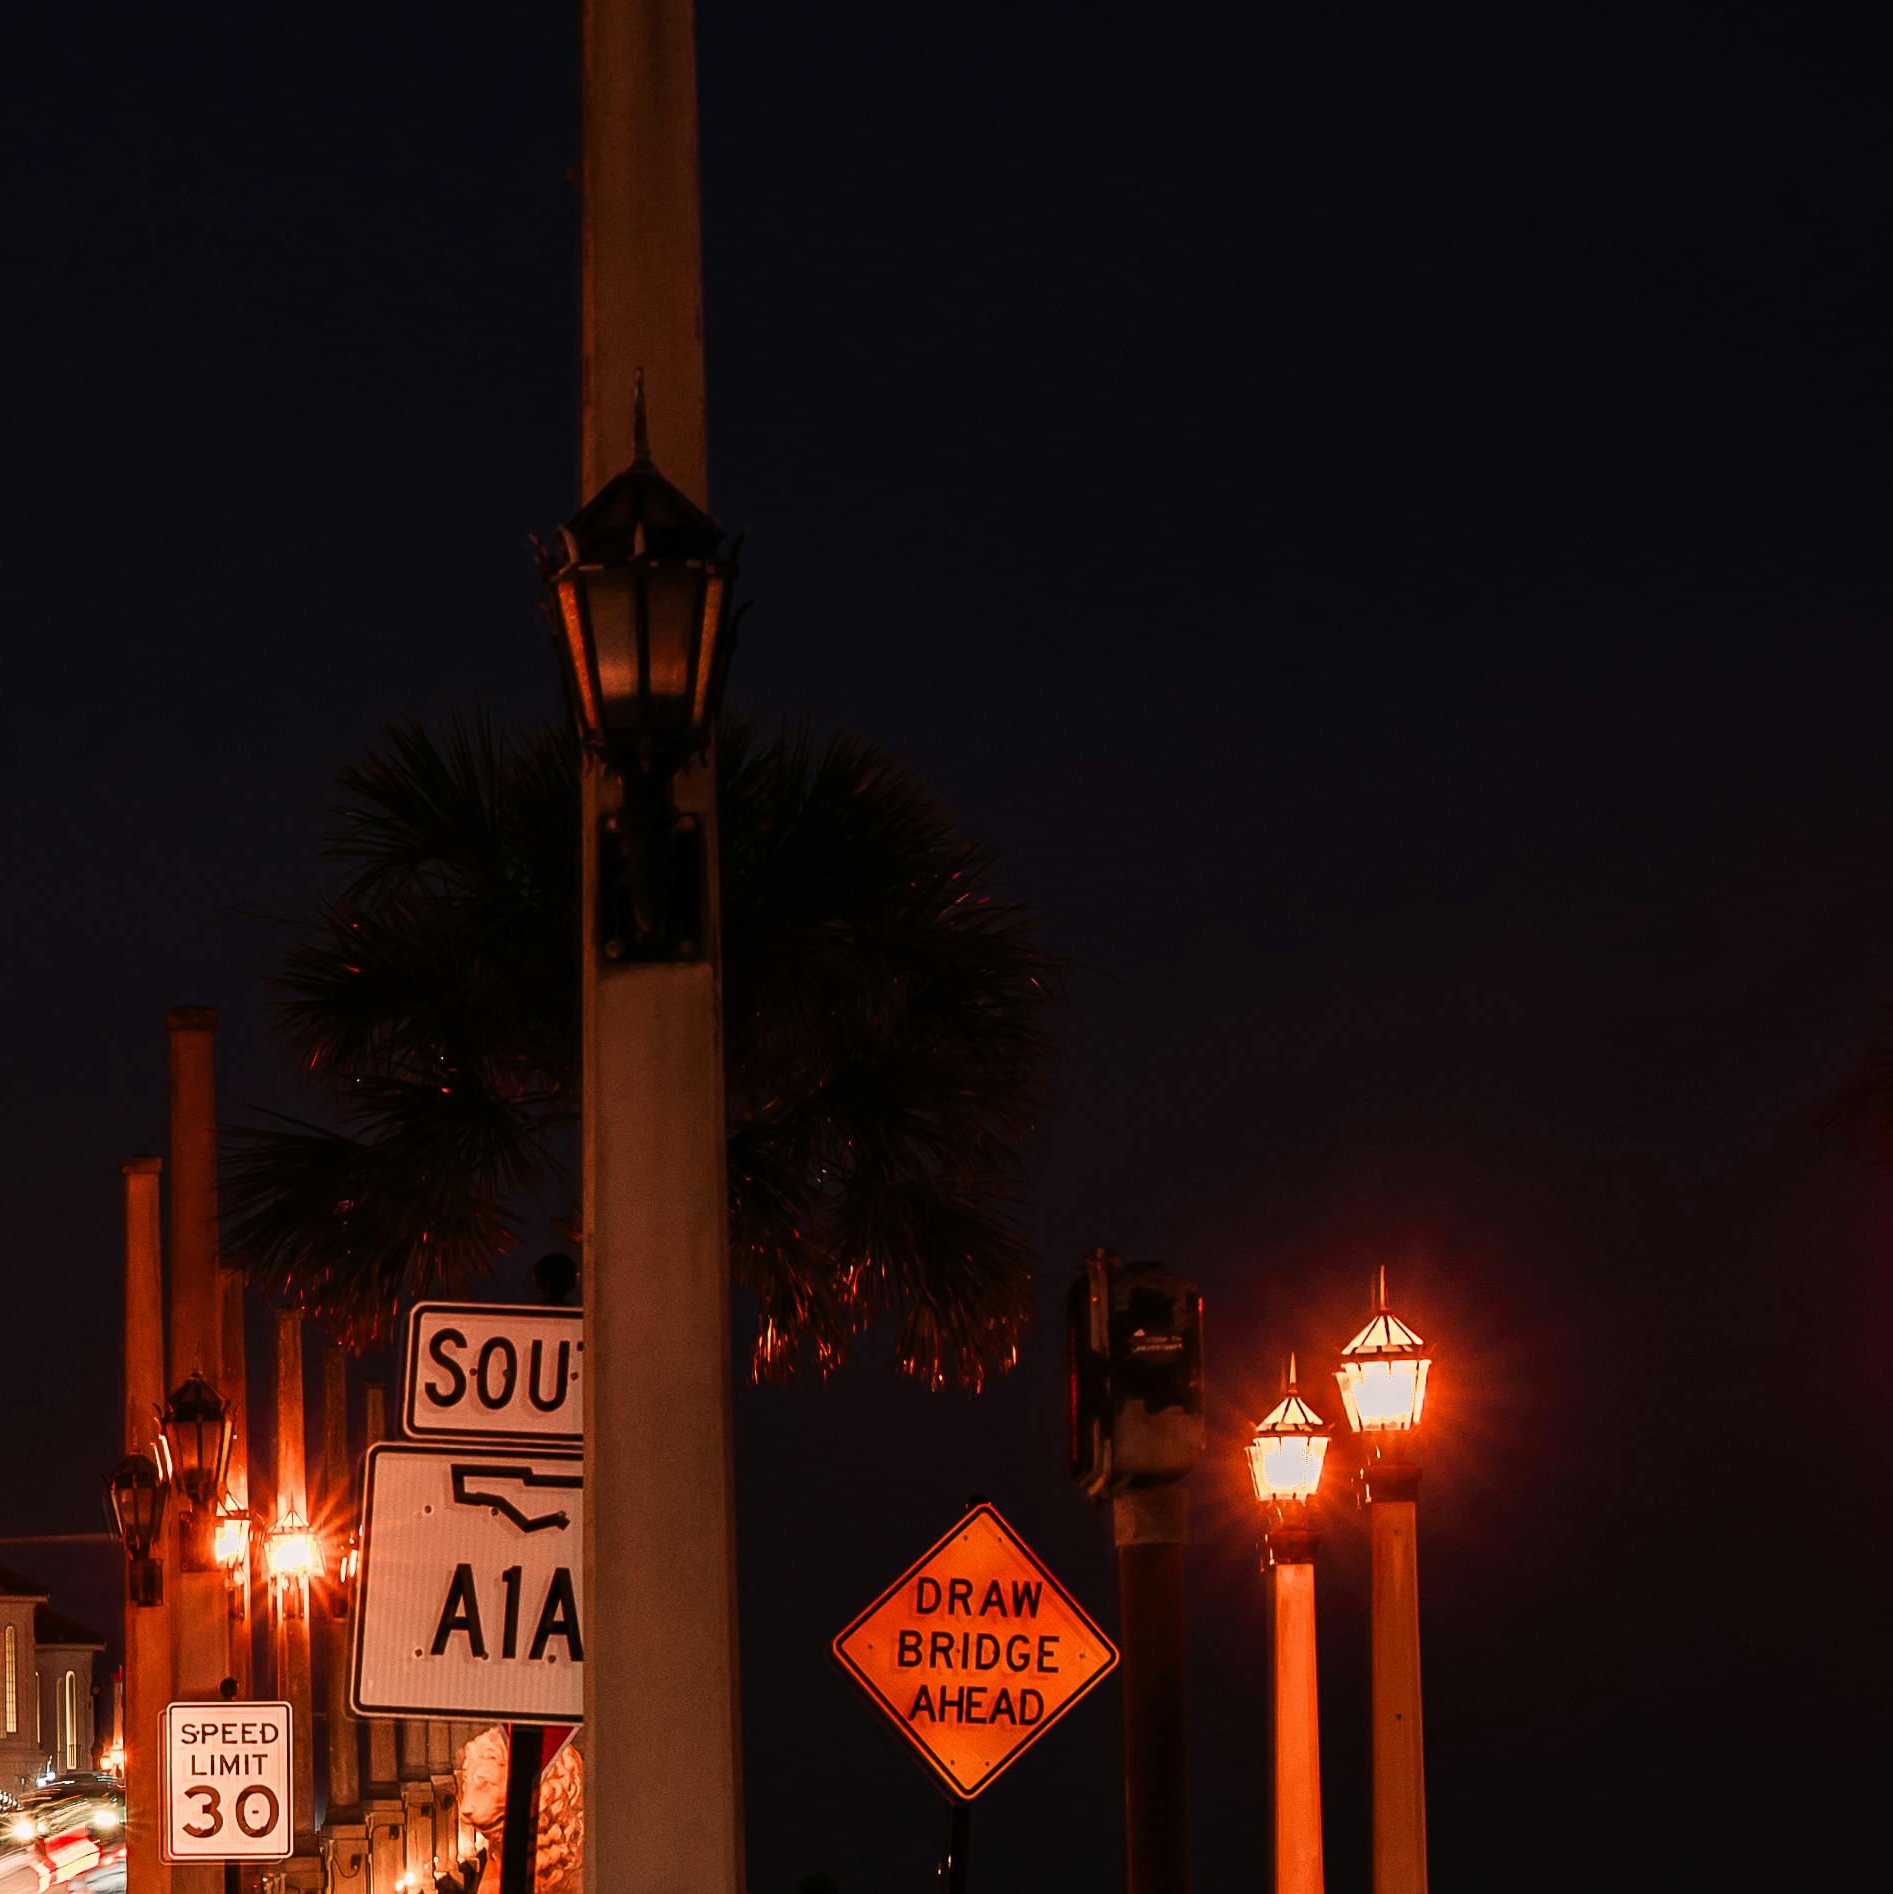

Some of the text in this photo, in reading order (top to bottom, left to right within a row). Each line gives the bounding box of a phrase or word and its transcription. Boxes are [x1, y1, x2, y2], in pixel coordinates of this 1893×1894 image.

[424, 1328, 584, 1412] SOU
[430, 1563, 584, 1661] A1A
[916, 1577, 1042, 1619] DRAW
[898, 1629, 1060, 1673] BRIDGE
[909, 1684, 1044, 1726] AHEAD
[181, 1723, 279, 1744] SPEED
[192, 1754, 268, 1775] LIMIT
[182, 1784, 279, 1838] 30
